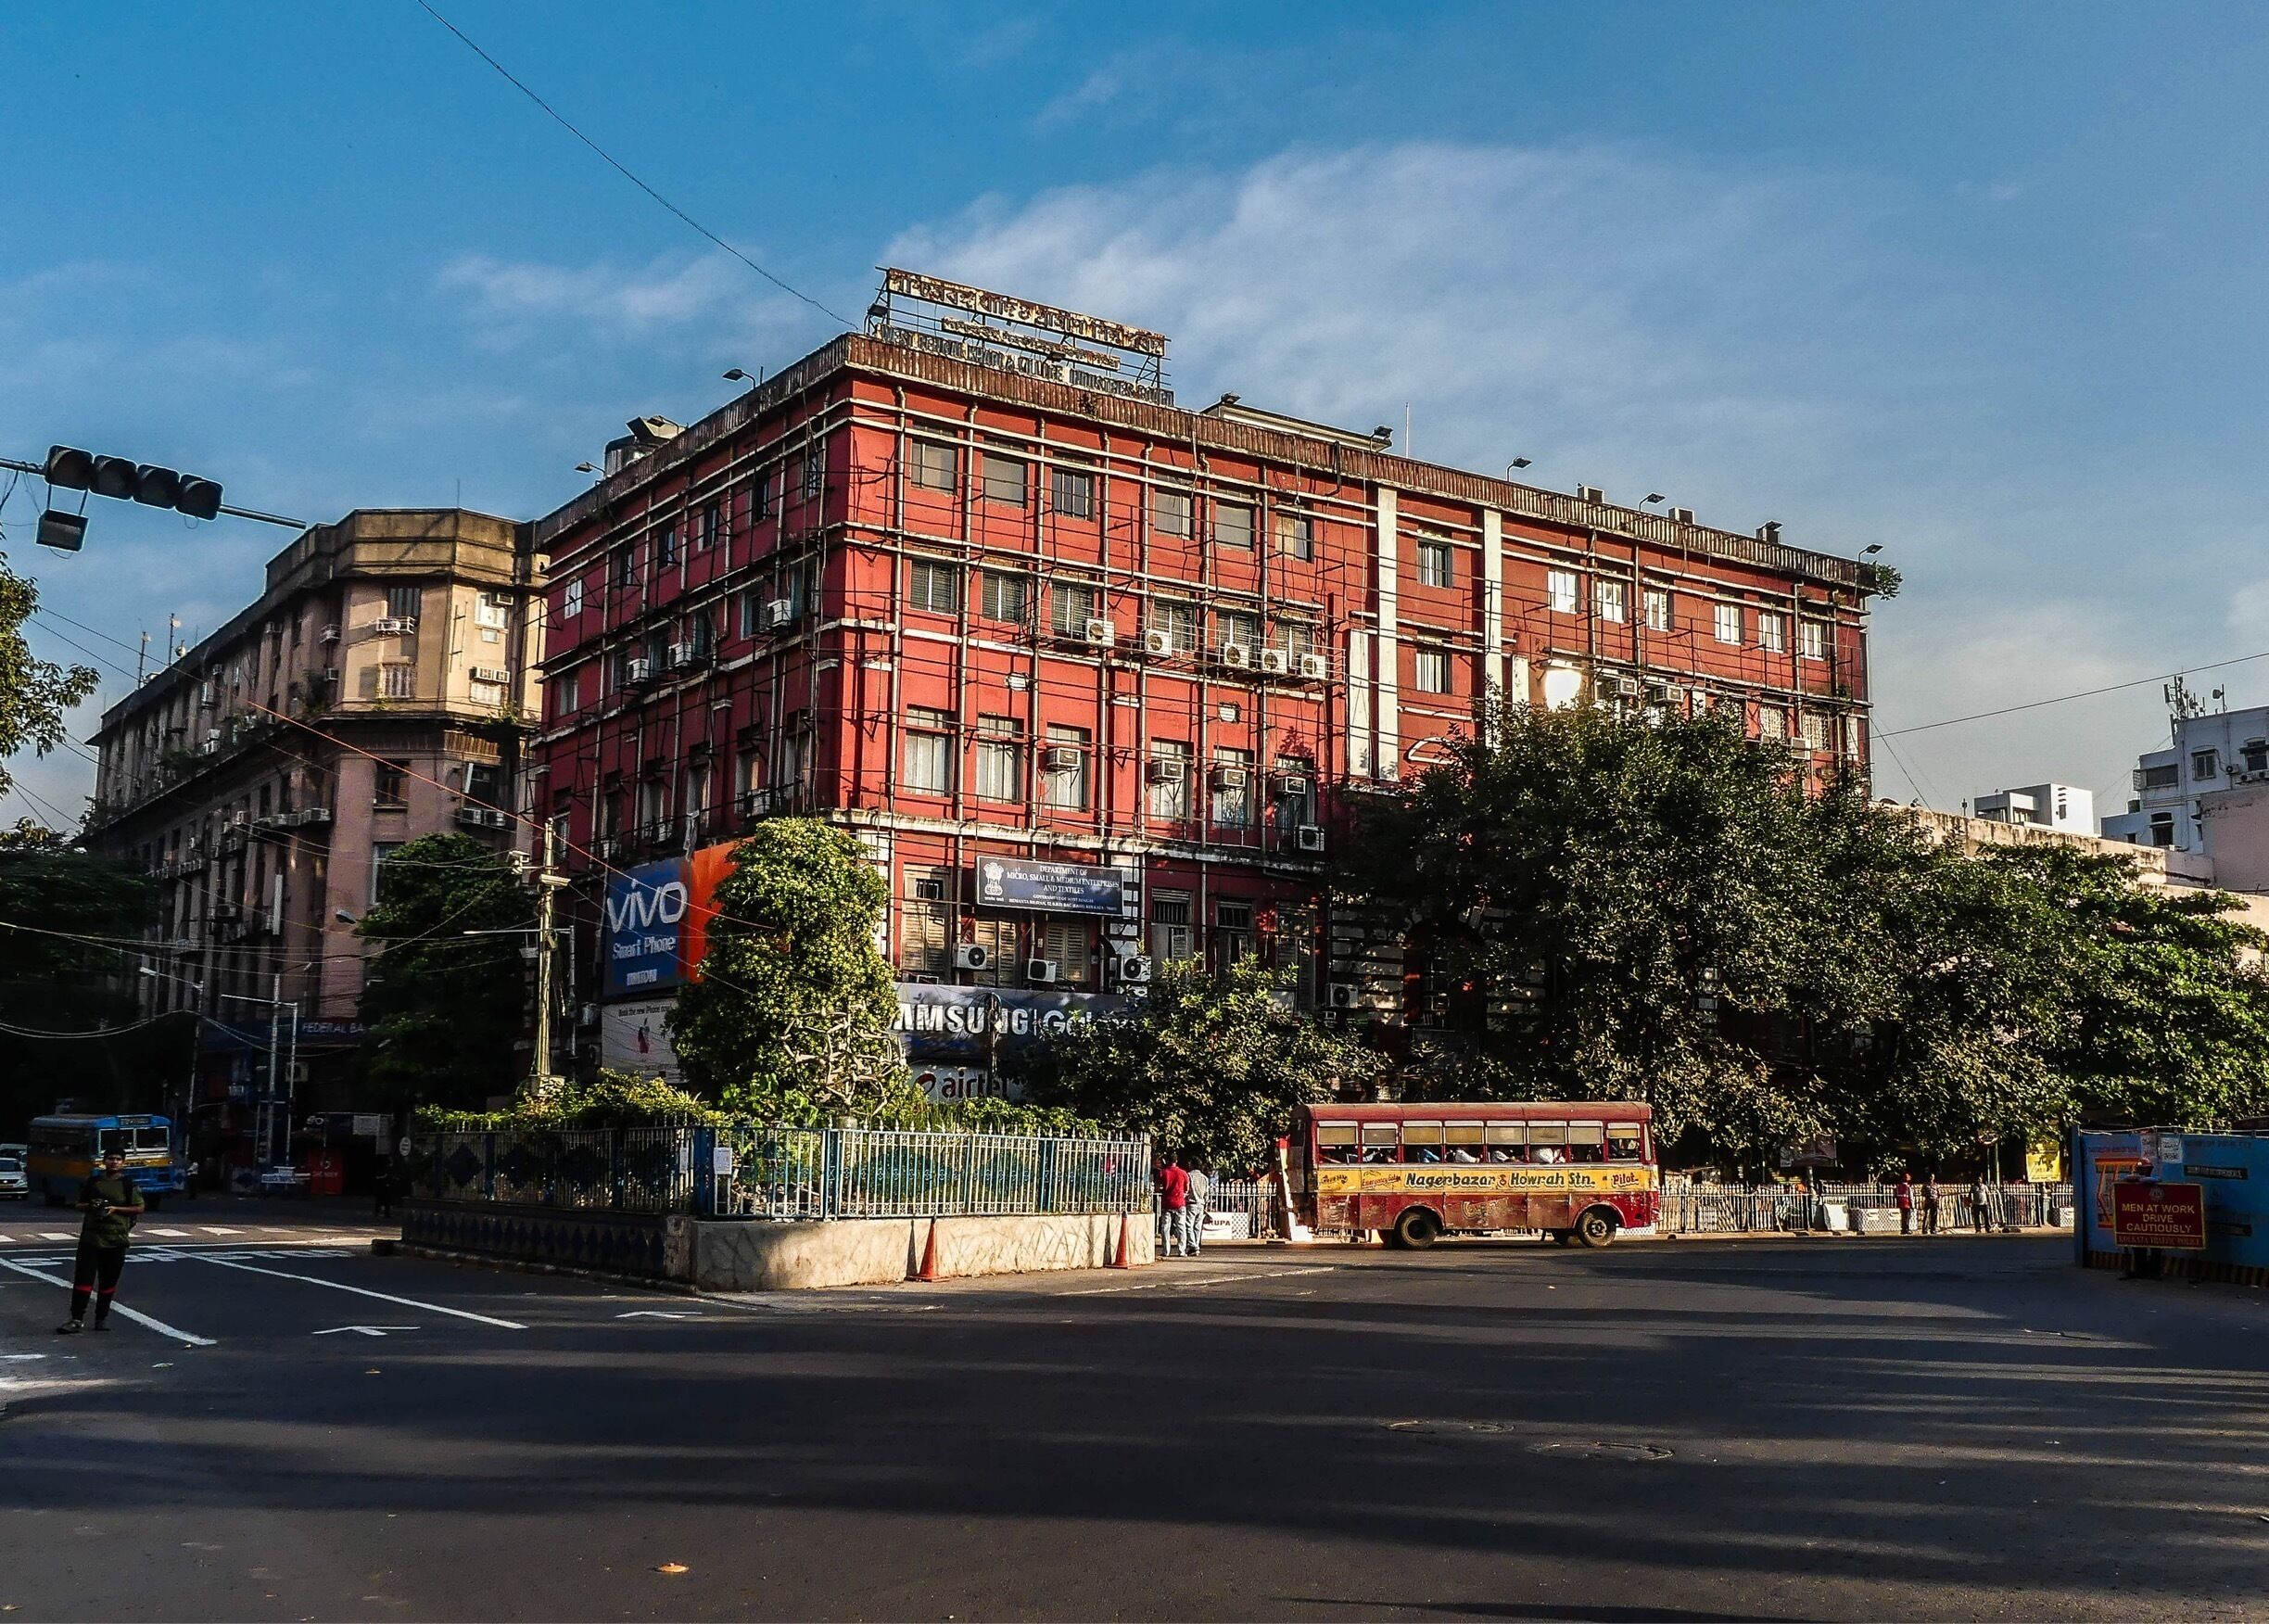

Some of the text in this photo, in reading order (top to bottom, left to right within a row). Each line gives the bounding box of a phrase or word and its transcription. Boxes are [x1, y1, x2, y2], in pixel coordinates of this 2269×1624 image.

[1040, 865, 1078, 876] DEPARTMENT
[1007, 871, 1029, 881] MICRO,
[1029, 874, 1050, 882] SMALL
[1057, 876, 1082, 885] MEDIUM
[1082, 878, 1120, 888] ENTERPRISES
[1043, 884, 1084, 894] AND TEXTILES
[606, 878, 688, 934] vivo
[613, 936, 676, 959] Smart Phone
[302, 1021, 348, 1034] FEDERAL
[1405, 1172, 1496, 1187] Nagerbazar
[1510, 1172, 1565, 1186] Howrah
[2122, 1203, 2195, 1214] MEN AT WORK
[2142, 1213, 2174, 1223] DRIVE
[2126, 1223, 2192, 1234] CAUTIOUSLY
